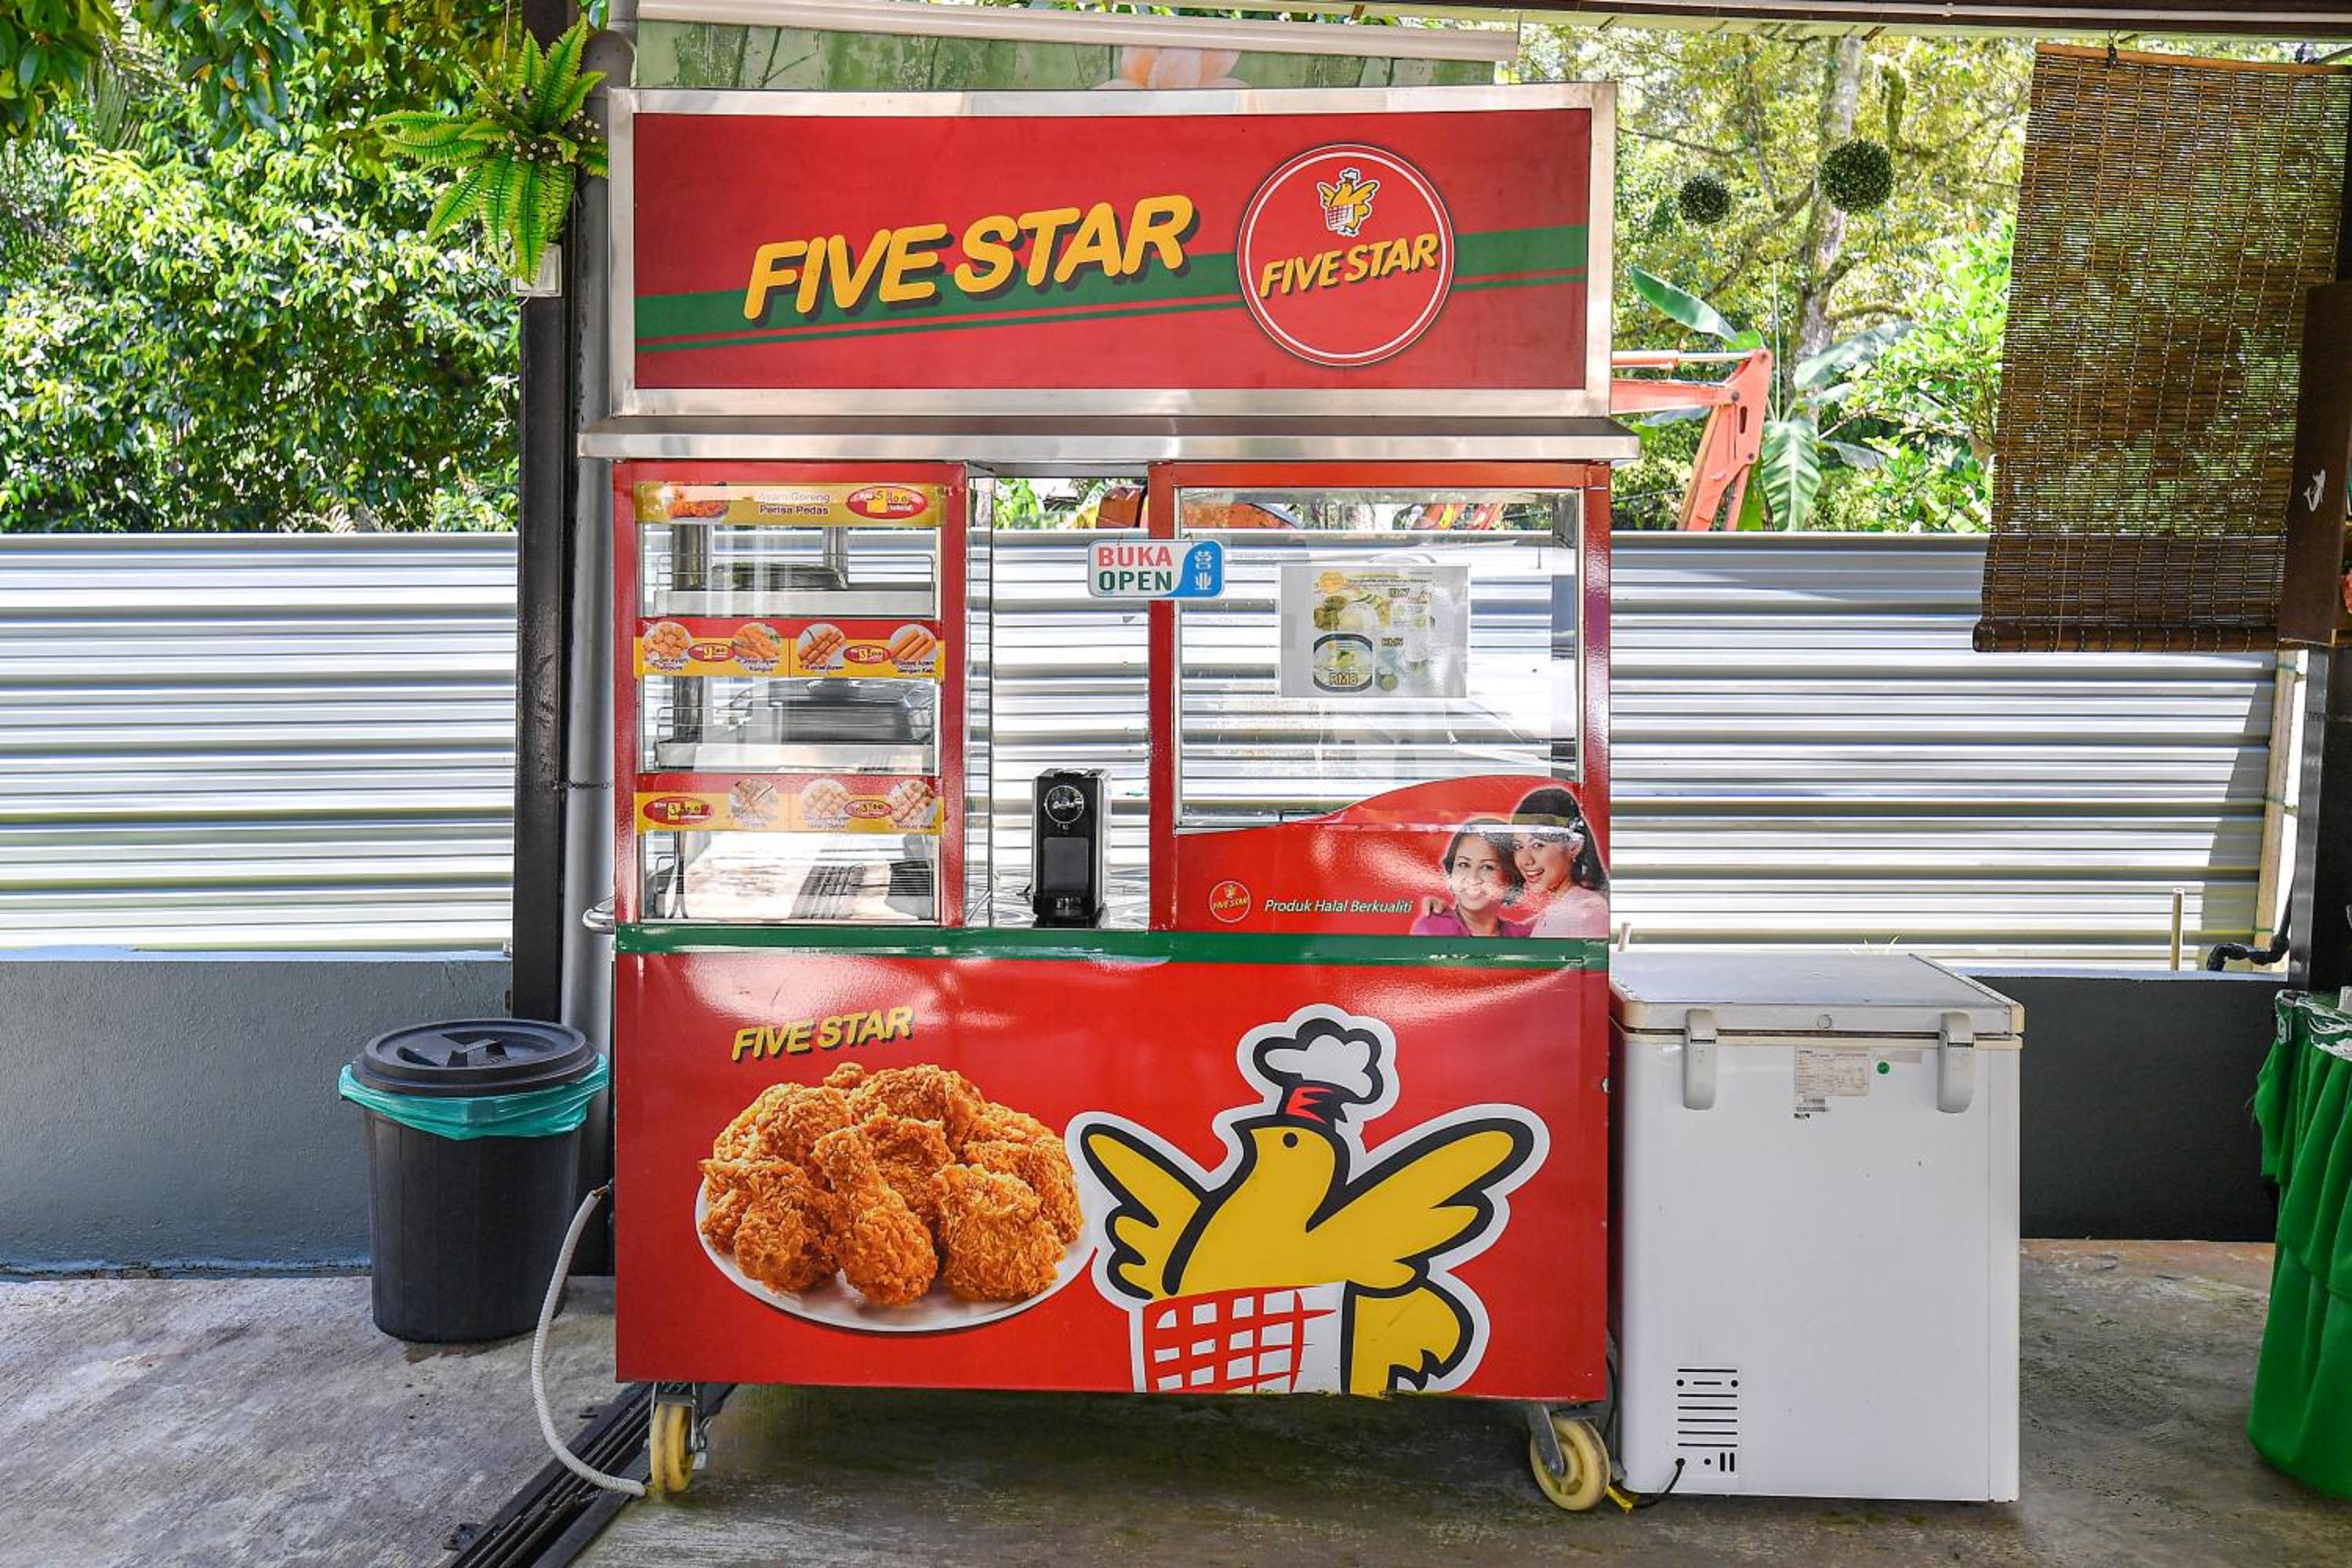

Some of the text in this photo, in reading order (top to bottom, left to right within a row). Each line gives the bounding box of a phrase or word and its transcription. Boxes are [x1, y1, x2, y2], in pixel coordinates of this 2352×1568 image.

[743, 194, 1196, 322] FIVE STAR
[1259, 233, 1439, 298] FIVE STAR
[759, 504, 829, 515] Perisa Pedas
[1098, 546, 1173, 567] BUKA
[1098, 571, 1173, 590] OPEN
[1264, 898, 1414, 914] Produk Halal Berkualiti
[731, 1005, 915, 1062] FIVE STAR
